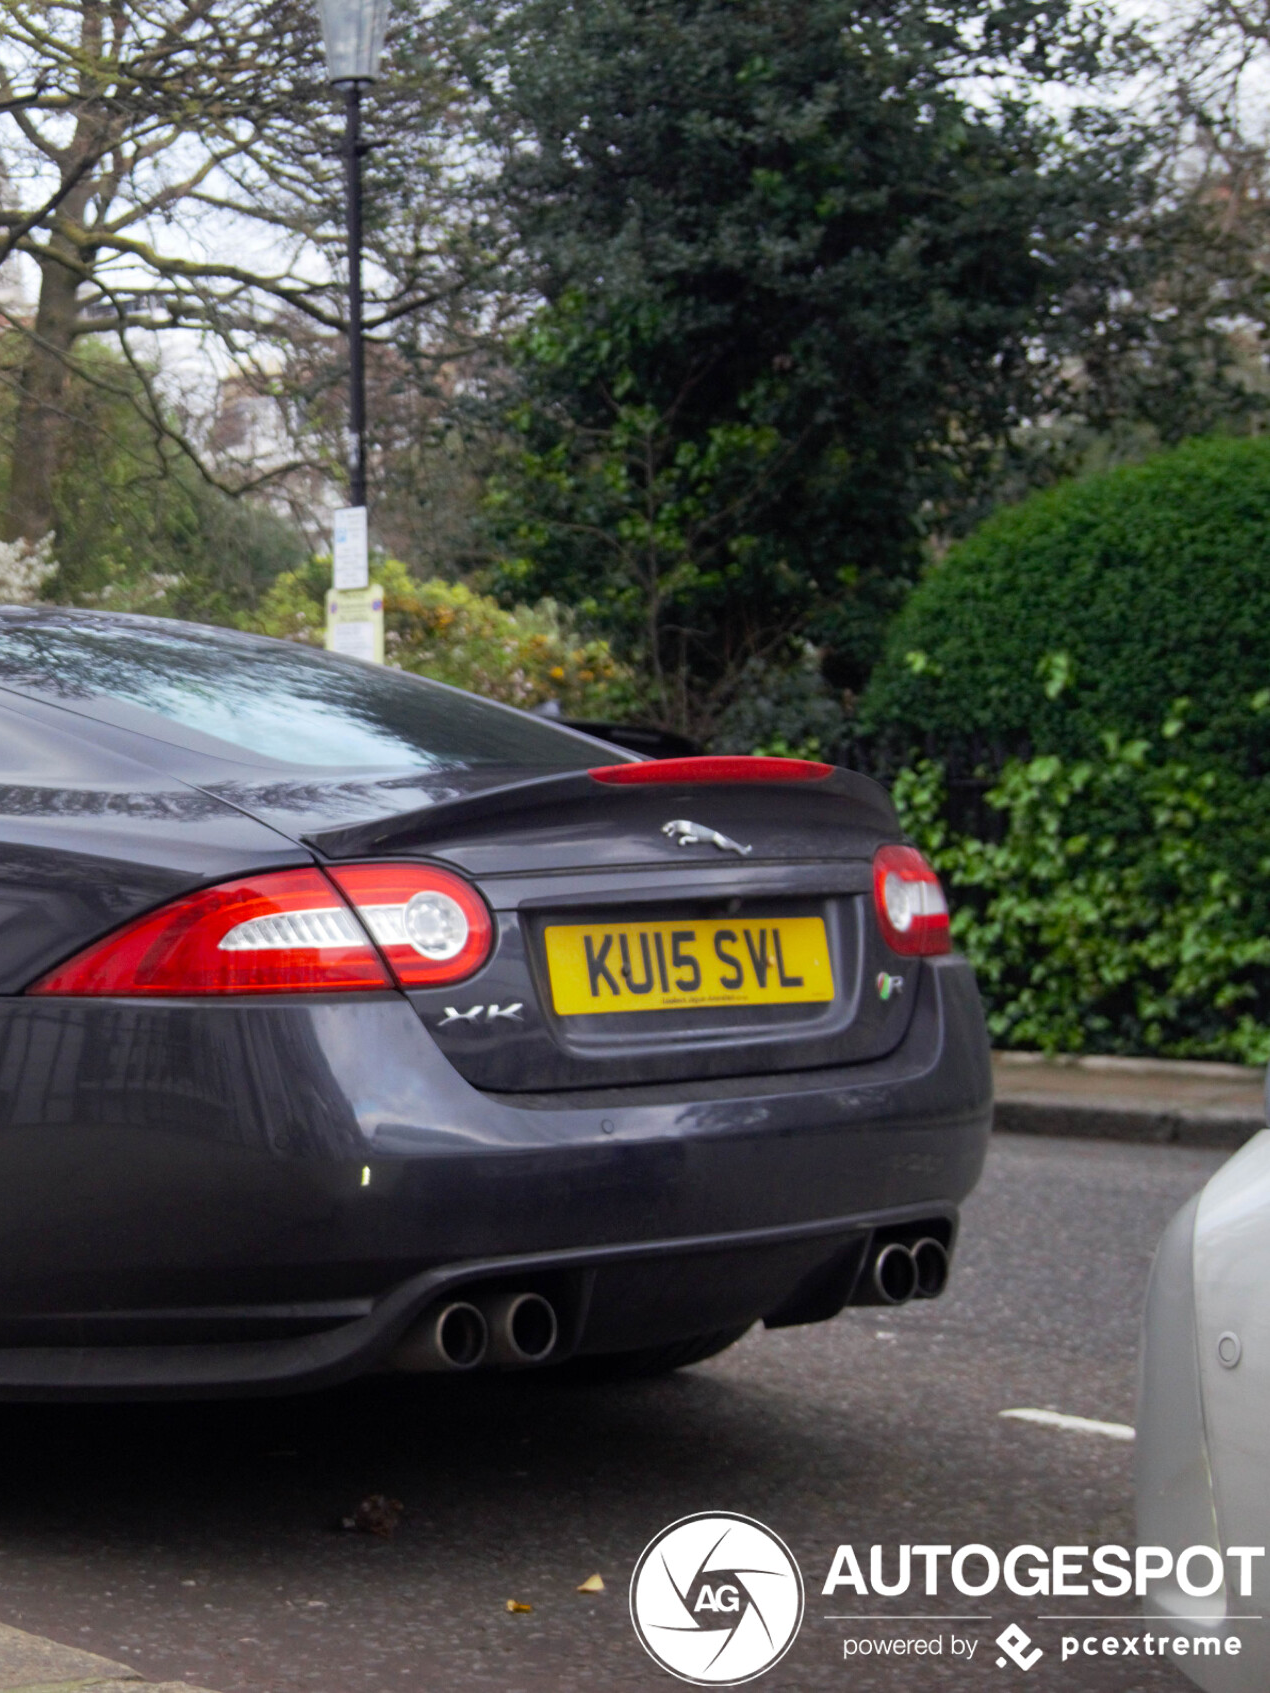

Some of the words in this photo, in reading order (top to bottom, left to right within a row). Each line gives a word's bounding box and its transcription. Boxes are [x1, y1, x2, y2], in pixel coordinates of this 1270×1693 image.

[583, 930, 701, 997] KU15
[713, 928, 804, 991] SVL
[437, 1002, 525, 1026] XK
